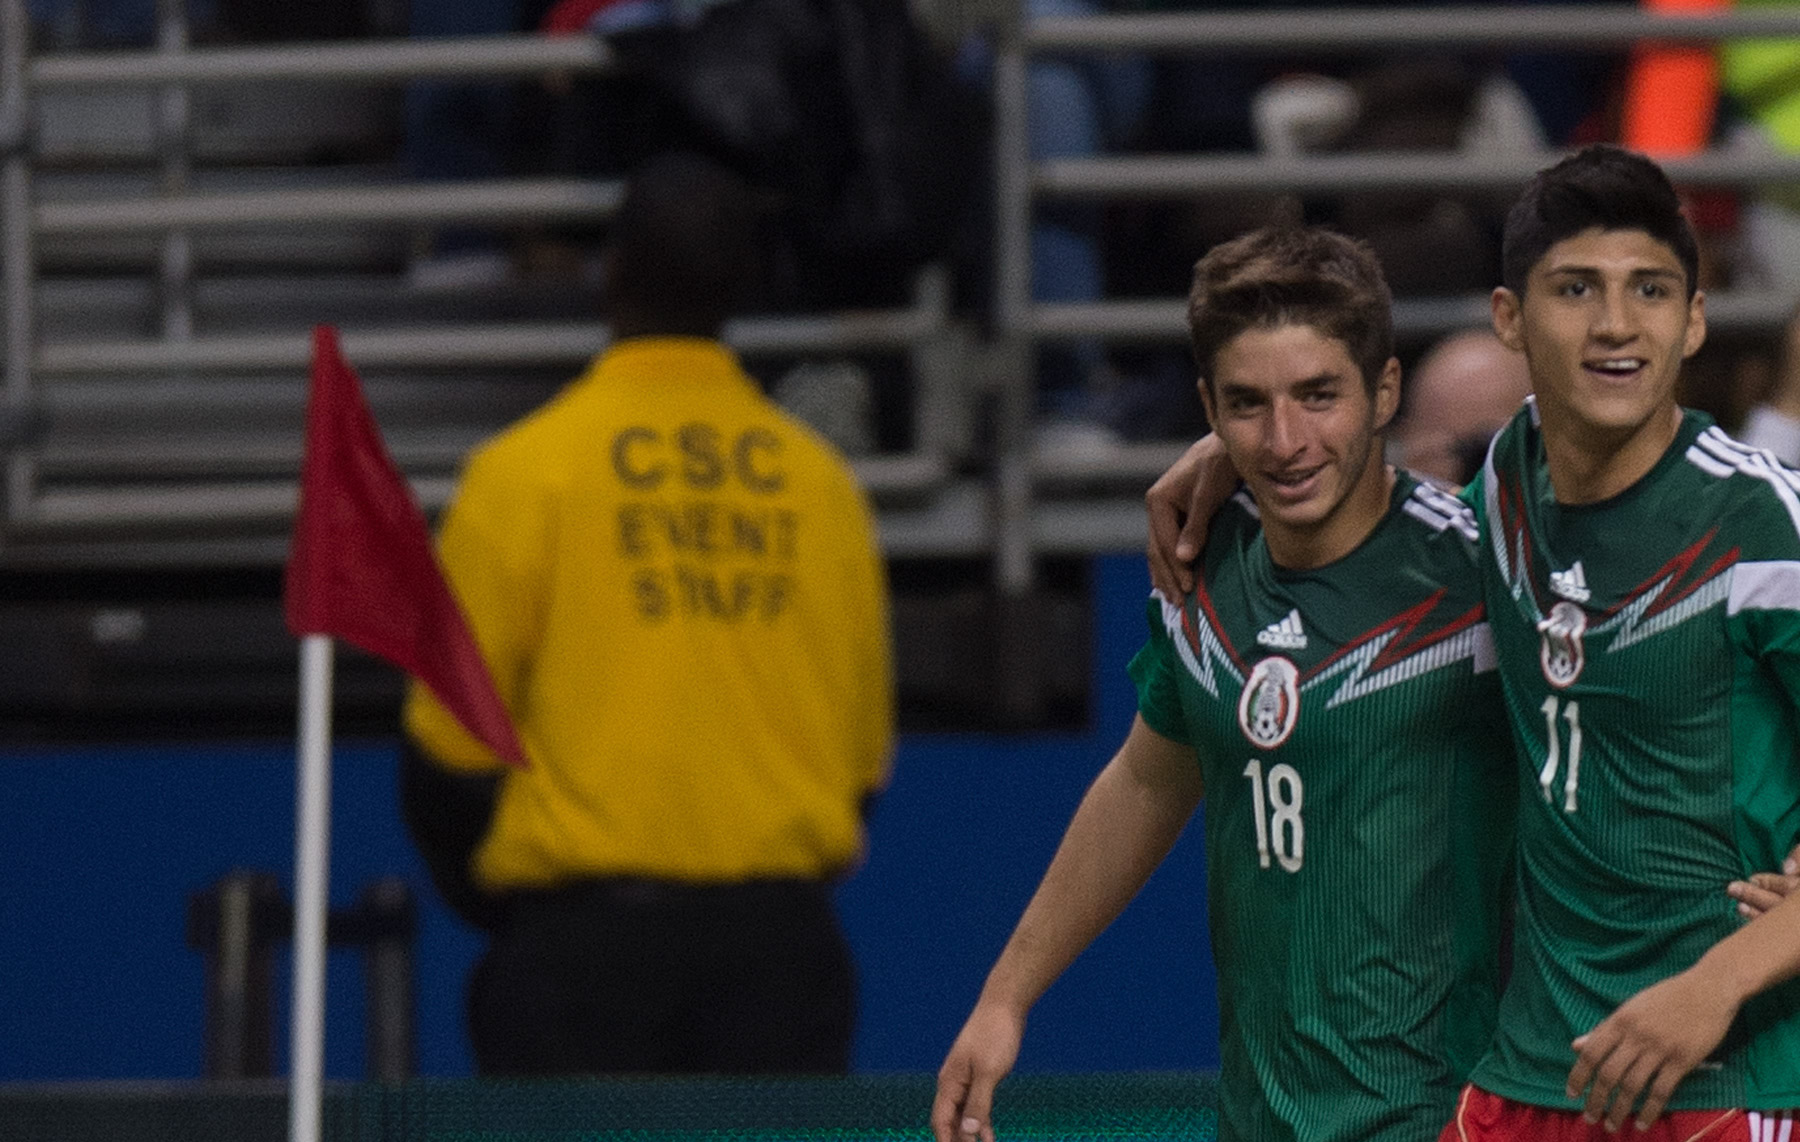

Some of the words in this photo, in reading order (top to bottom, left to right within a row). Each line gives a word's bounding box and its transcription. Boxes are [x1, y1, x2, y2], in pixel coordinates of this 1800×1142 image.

[608, 424, 788, 494] CSC
[615, 502, 798, 560] EVENT
[632, 564, 796, 626] STAFF
[1540, 696, 1581, 813] 11
[1243, 759, 1304, 873] 18
